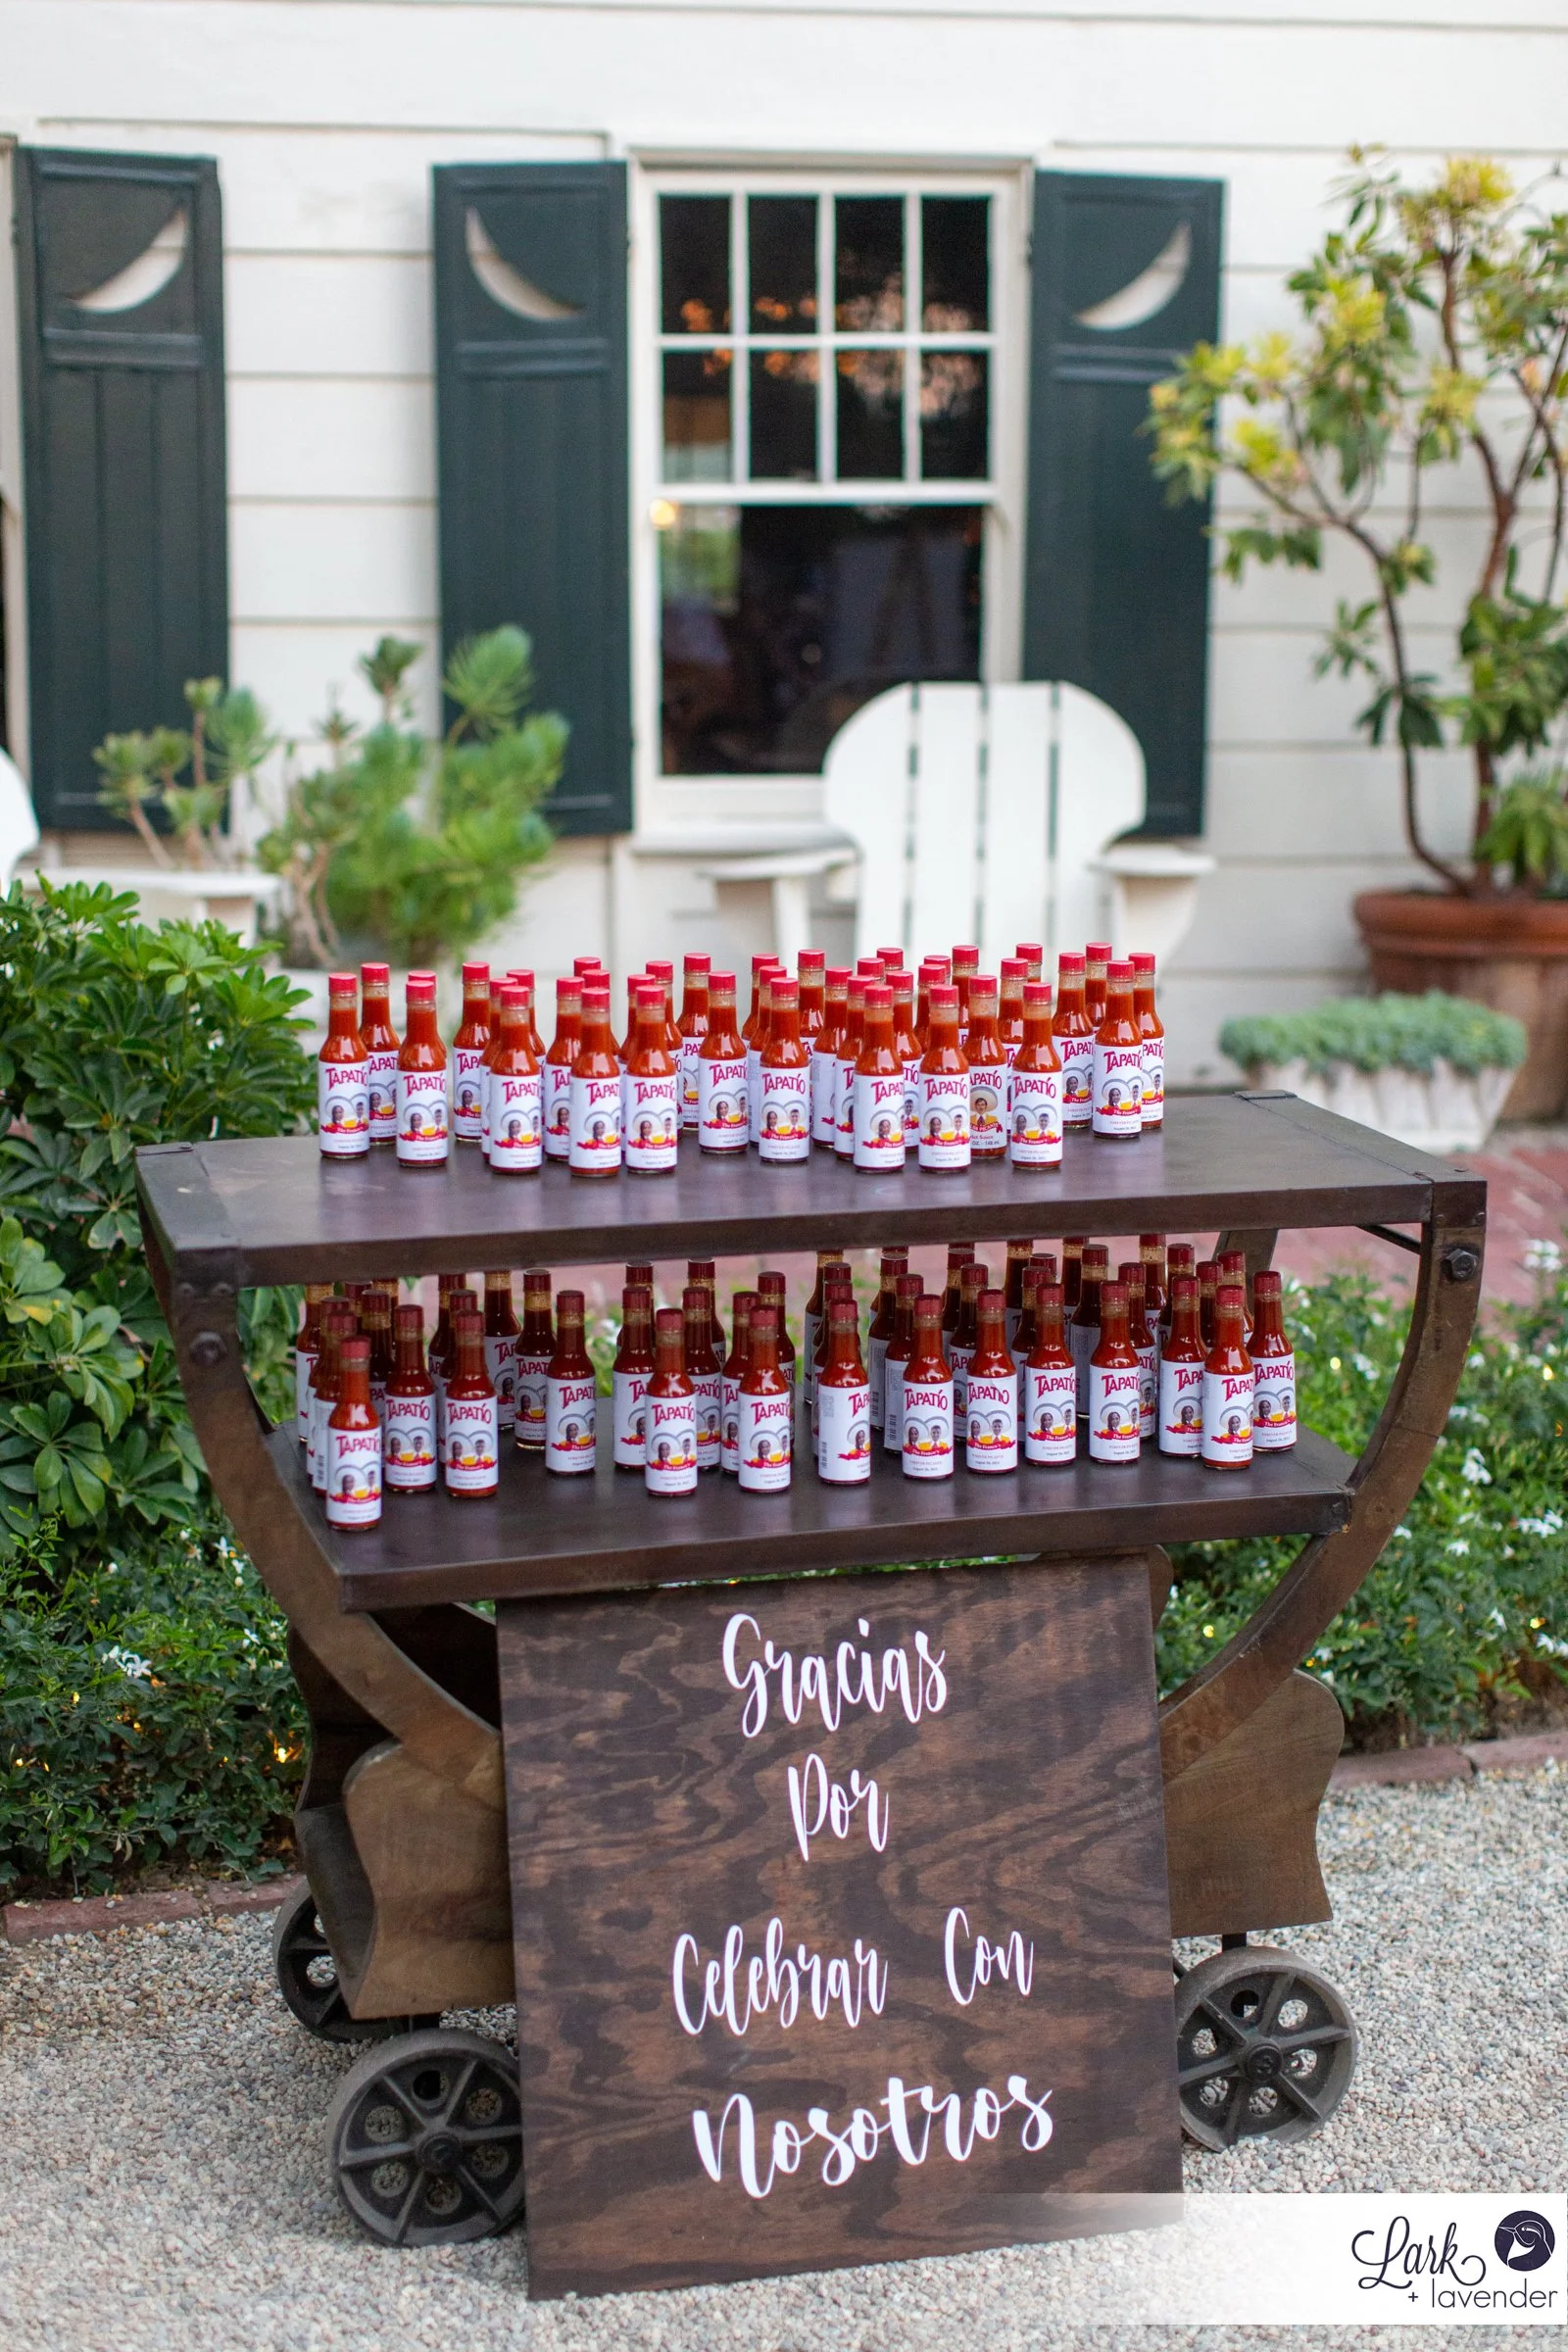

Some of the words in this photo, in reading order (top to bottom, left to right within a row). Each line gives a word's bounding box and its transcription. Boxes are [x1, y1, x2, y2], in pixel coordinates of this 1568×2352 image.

[710, 1062, 748, 1088] TAPATÍ
[761, 1071, 807, 1097] TAPATÍO
[1012, 1075, 1057, 1100] TAPATÍO
[924, 1076, 969, 1102] TAPATÍO
[385, 1398, 431, 1421] TAPATÍO
[905, 1388, 949, 1411] TAPATÍO
[447, 1402, 492, 1425] TAPATÍO
[722, 1612, 948, 1738] Gracias
[787, 1753, 889, 1861] Por
[672, 1916, 888, 2036] Celebrar
[944, 1906, 1034, 2006] Con
[692, 2074, 1054, 2199] Nosotros
